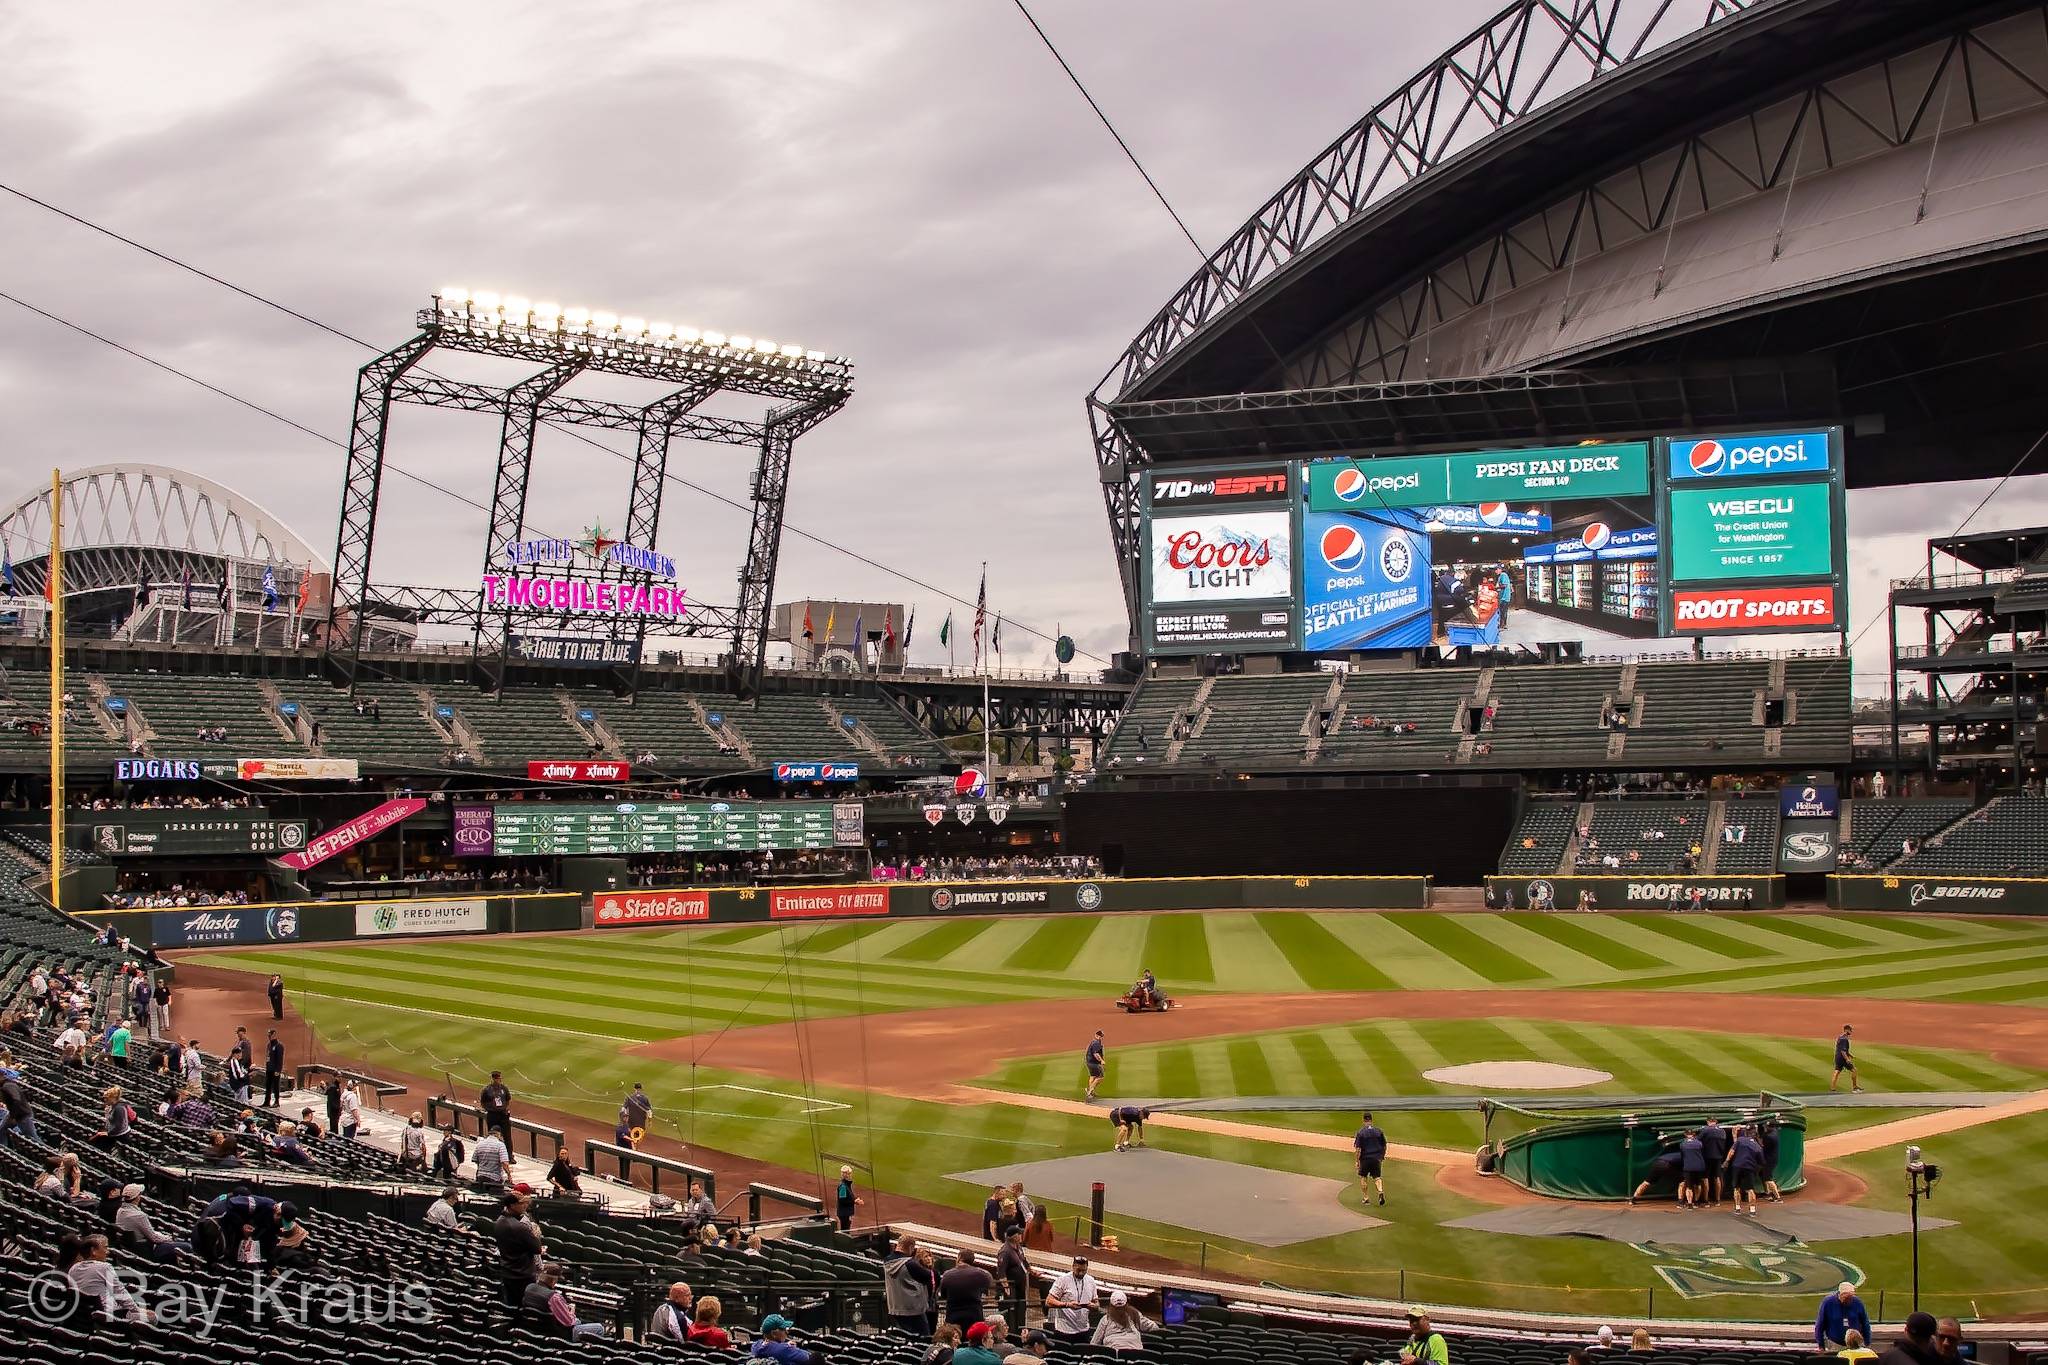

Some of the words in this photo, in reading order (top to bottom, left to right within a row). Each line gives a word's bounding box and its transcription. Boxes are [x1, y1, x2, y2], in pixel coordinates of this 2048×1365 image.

[1729, 439, 1807, 470] pepsi
[1475, 461, 1526, 478] PEPSI
[1529, 459, 1567, 475] FAN
[1569, 456, 1620, 473] DECK
[1154, 480, 1193, 499] 710
[1214, 474, 1287, 496] ESPN
[1368, 472, 1419, 494] pepsi
[1523, 476, 1555, 488] SECTION
[1556, 476, 1570, 486] 149
[1707, 497, 1794, 517] WSECU
[1435, 507, 1478, 524] pepsi
[1714, 523, 1731, 532] The
[1732, 522, 1760, 532] Credit
[1762, 521, 1788, 530] Union
[1611, 535, 1630, 545] Fan
[1718, 535, 1732, 544] for
[1732, 533, 1785, 544] Washington
[1167, 530, 1274, 570] Coors
[506, 539, 573, 568] SEATTLE
[610, 543, 677, 579] MARINERS
[1721, 555, 1754, 565] SINCE
[1188, 568, 1254, 589] LIGHT
[1326, 574, 1365, 593] pepsi
[482, 573, 613, 612] T-MOBILE
[615, 582, 689, 617] PARK
[1357, 593, 1379, 606] SOFT
[1373, 593, 1418, 615] MARINERS
[1678, 598, 1744, 620] ROOT
[1745, 599, 1826, 618] SPORTS
[1156, 616, 1192, 625] EXPECT
[1156, 624, 1192, 632] EXPECT
[1156, 633, 1176, 642] VISIT
[533, 637, 564, 660] TRUE
[565, 640, 579, 660] TO
[579, 641, 601, 661] THE
[601, 641, 632, 663] BLUE
[117, 760, 200, 780] EDGARS
[542, 763, 577, 779] xfinity
[586, 763, 620, 779] xfinity
[790, 766, 816, 779] pepsi
[834, 766, 858, 779] pepsi
[1795, 801, 1823, 810] Holland
[455, 811, 492, 819] EMERALD
[836, 808, 860, 819] BUILT
[928, 811, 940, 821] 42
[461, 818, 486, 826] QUEEN
[127, 833, 158, 842] Chicago
[837, 832, 860, 841] TOUGH
[128, 845, 153, 853] Seattle
[297, 841, 329, 866] THE
[1294, 877, 1310, 888] 401
[739, 889, 755, 899] 376
[954, 892, 998, 906] JIMMY
[1001, 891, 1048, 905] JOHN'S
[1932, 886, 2006, 898] BOEING
[775, 895, 834, 911] Emirates
[837, 895, 852, 908] FLY
[853, 893, 885, 908] BETTER
[403, 908, 432, 918] FRED
[435, 907, 471, 917] HUTCH
[184, 912, 240, 931] Alaska
[187, 932, 235, 941] AIRLINES
